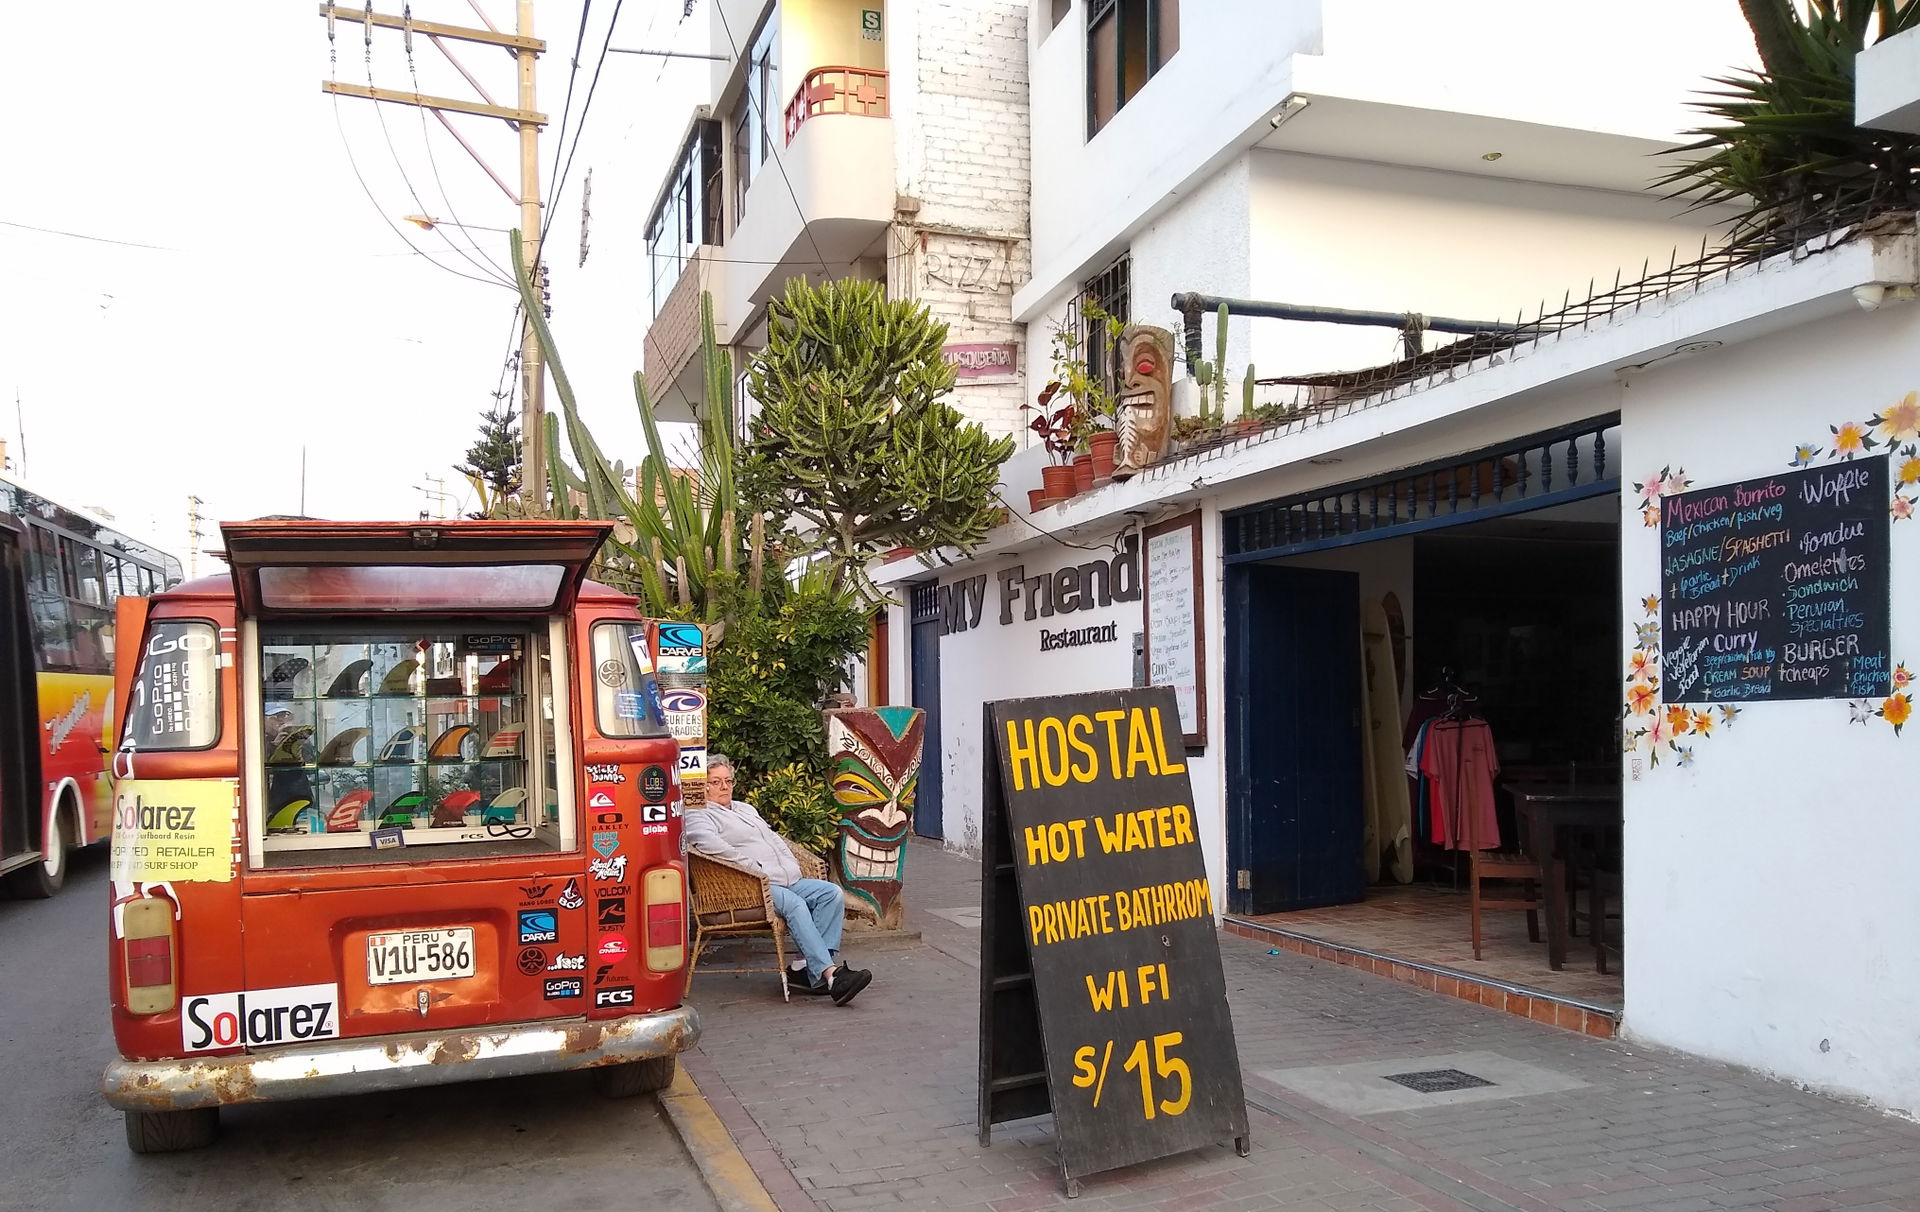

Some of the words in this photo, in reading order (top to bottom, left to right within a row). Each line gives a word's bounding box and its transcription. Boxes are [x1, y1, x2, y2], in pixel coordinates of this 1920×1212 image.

[1672, 604, 1720, 631] HAPPY
[1728, 599, 1771, 628] HOUR
[467, 635, 518, 644] GoPro
[1040, 620, 1118, 651] Restaurant
[1714, 630, 1758, 652] Curry
[1784, 634, 1860, 663] BURGER
[152, 664, 164, 735] GoPro
[1006, 706, 1186, 791] HOSTAL
[116, 794, 196, 831] Solarez
[379, 837, 396, 845] VISA
[642, 825, 668, 835] globe
[1024, 819, 1087, 865] HOT
[1095, 804, 1195, 855] WATER
[156, 846, 215, 857] RETAILER
[144, 861, 168, 870] SURF
[169, 861, 198, 870] SHOP
[594, 886, 632, 897] VOLCOM
[1028, 895, 1114, 946] PRIVATE
[1115, 878, 1213, 931] BATHRROM
[402, 932, 440, 945] PERU
[373, 941, 470, 977] V1U-586
[546, 981, 581, 991] GoPro
[597, 990, 633, 1005] FCS
[188, 994, 333, 1049] Solarez
